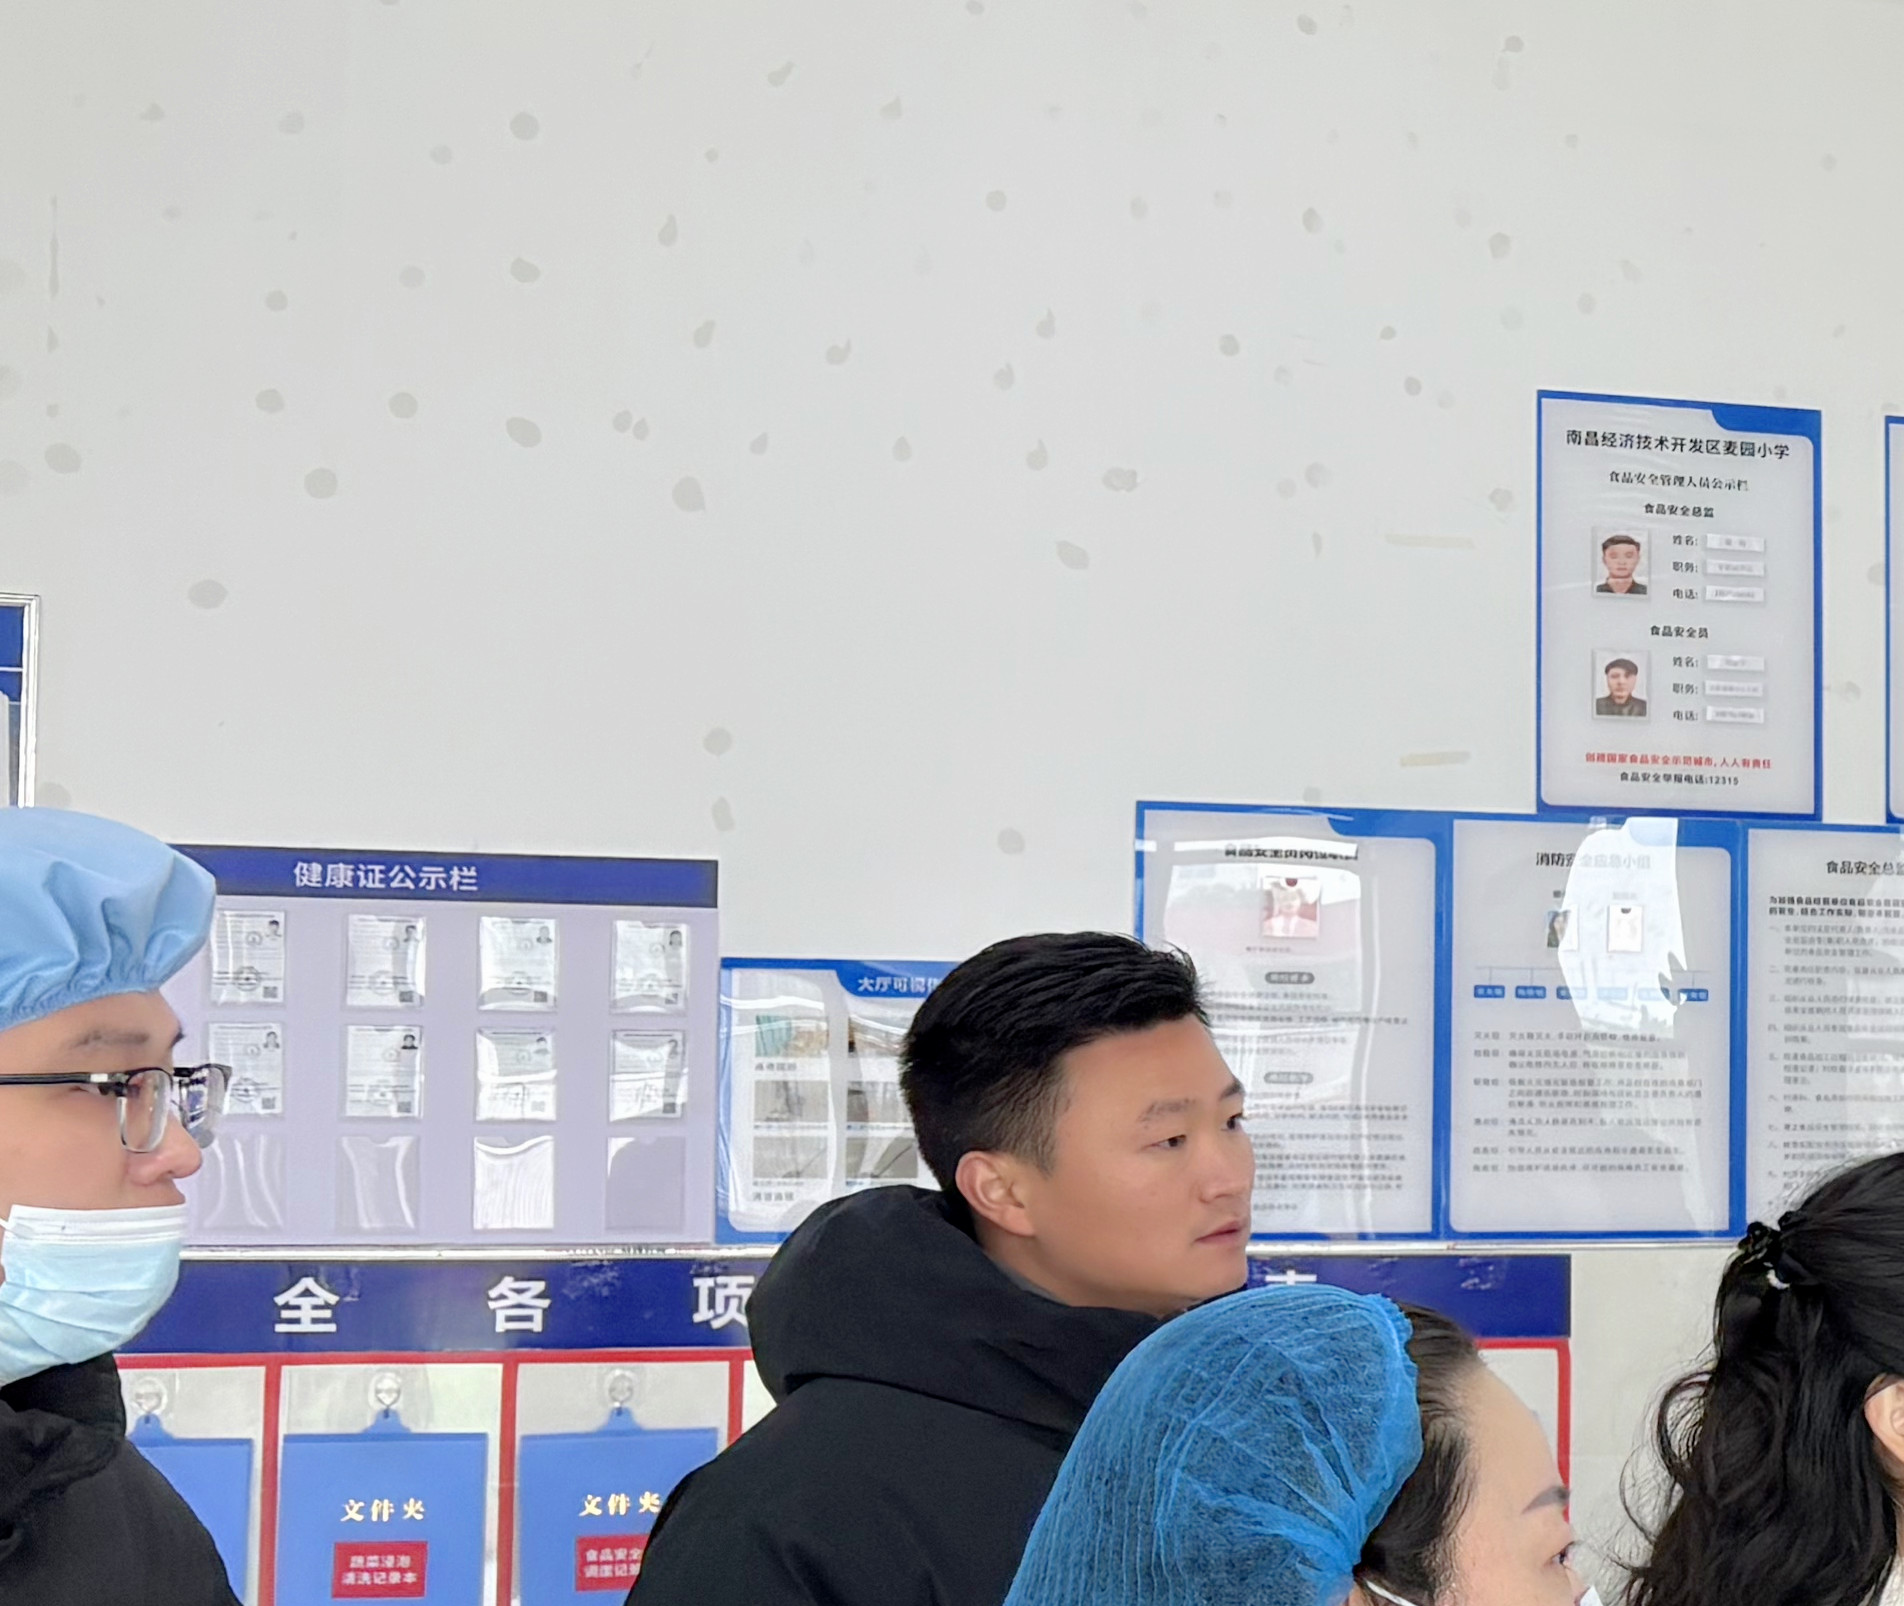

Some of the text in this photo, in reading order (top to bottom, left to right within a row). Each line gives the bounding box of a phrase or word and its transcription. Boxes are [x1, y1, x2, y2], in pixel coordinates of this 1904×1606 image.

[1565, 428, 1790, 460] 南昌经济技术开发区麦园小学
[1609, 470, 1750, 492] 食品安全管理人员公示栏
[1644, 503, 1715, 519] 食品安全总监
[1650, 625, 1709, 639] 食品安全员
[294, 862, 479, 892] 健康证公示栏
[340, 1498, 425, 1522] 文件夹
[578, 1491, 661, 1516] 文件夹
